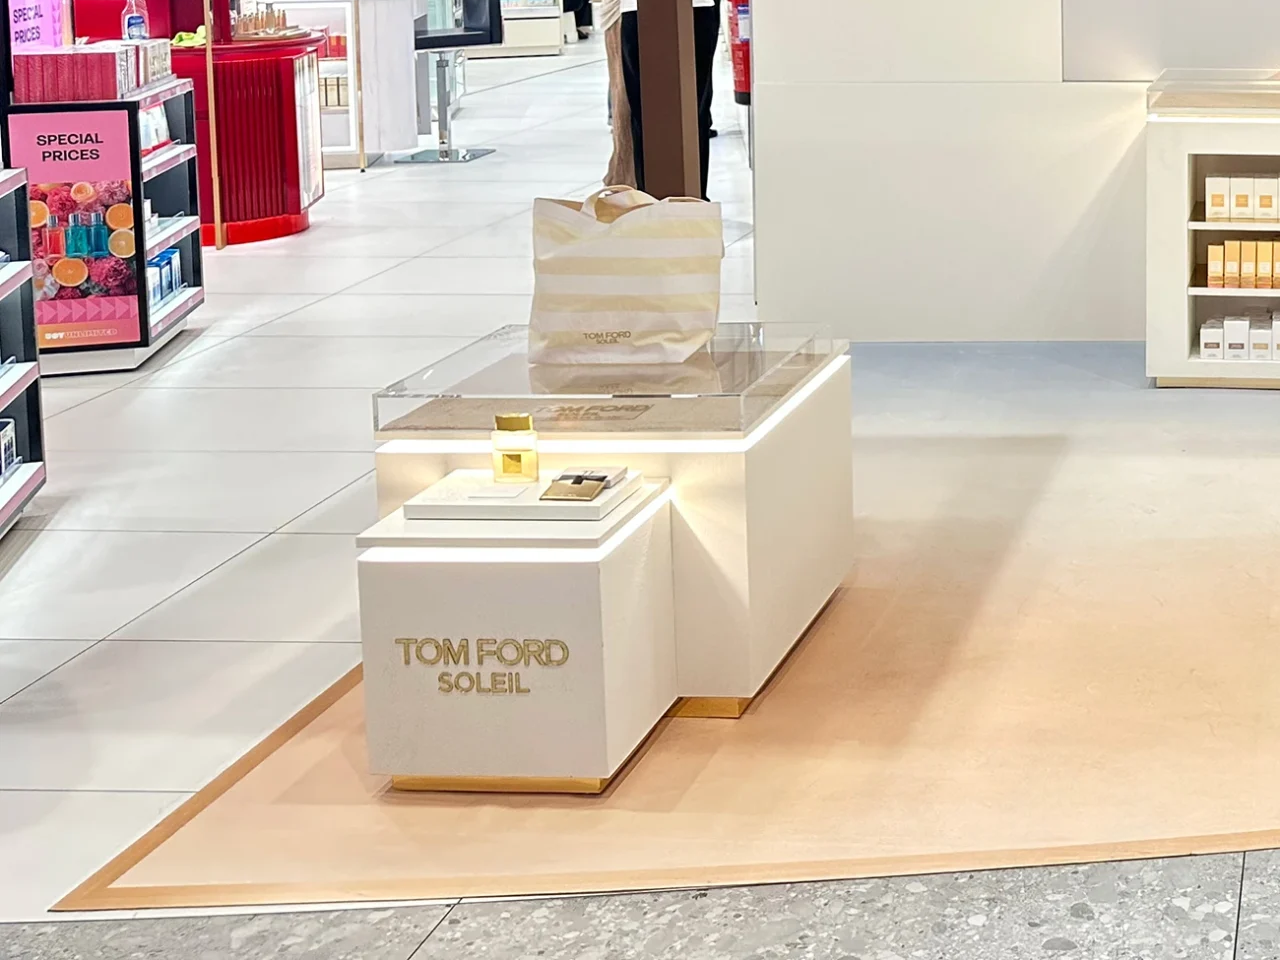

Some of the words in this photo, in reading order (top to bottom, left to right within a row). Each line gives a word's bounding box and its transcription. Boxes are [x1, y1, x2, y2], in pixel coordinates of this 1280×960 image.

[14, 26, 41, 44] PRICES
[36, 132, 104, 147] SPECIAL
[42, 148, 100, 162] PRICES
[583, 332, 604, 340] TOM
[605, 330, 631, 339] FORD
[395, 638, 470, 666] TOM
[476, 638, 570, 667] FORD
[438, 671, 531, 694] SOLEIL
